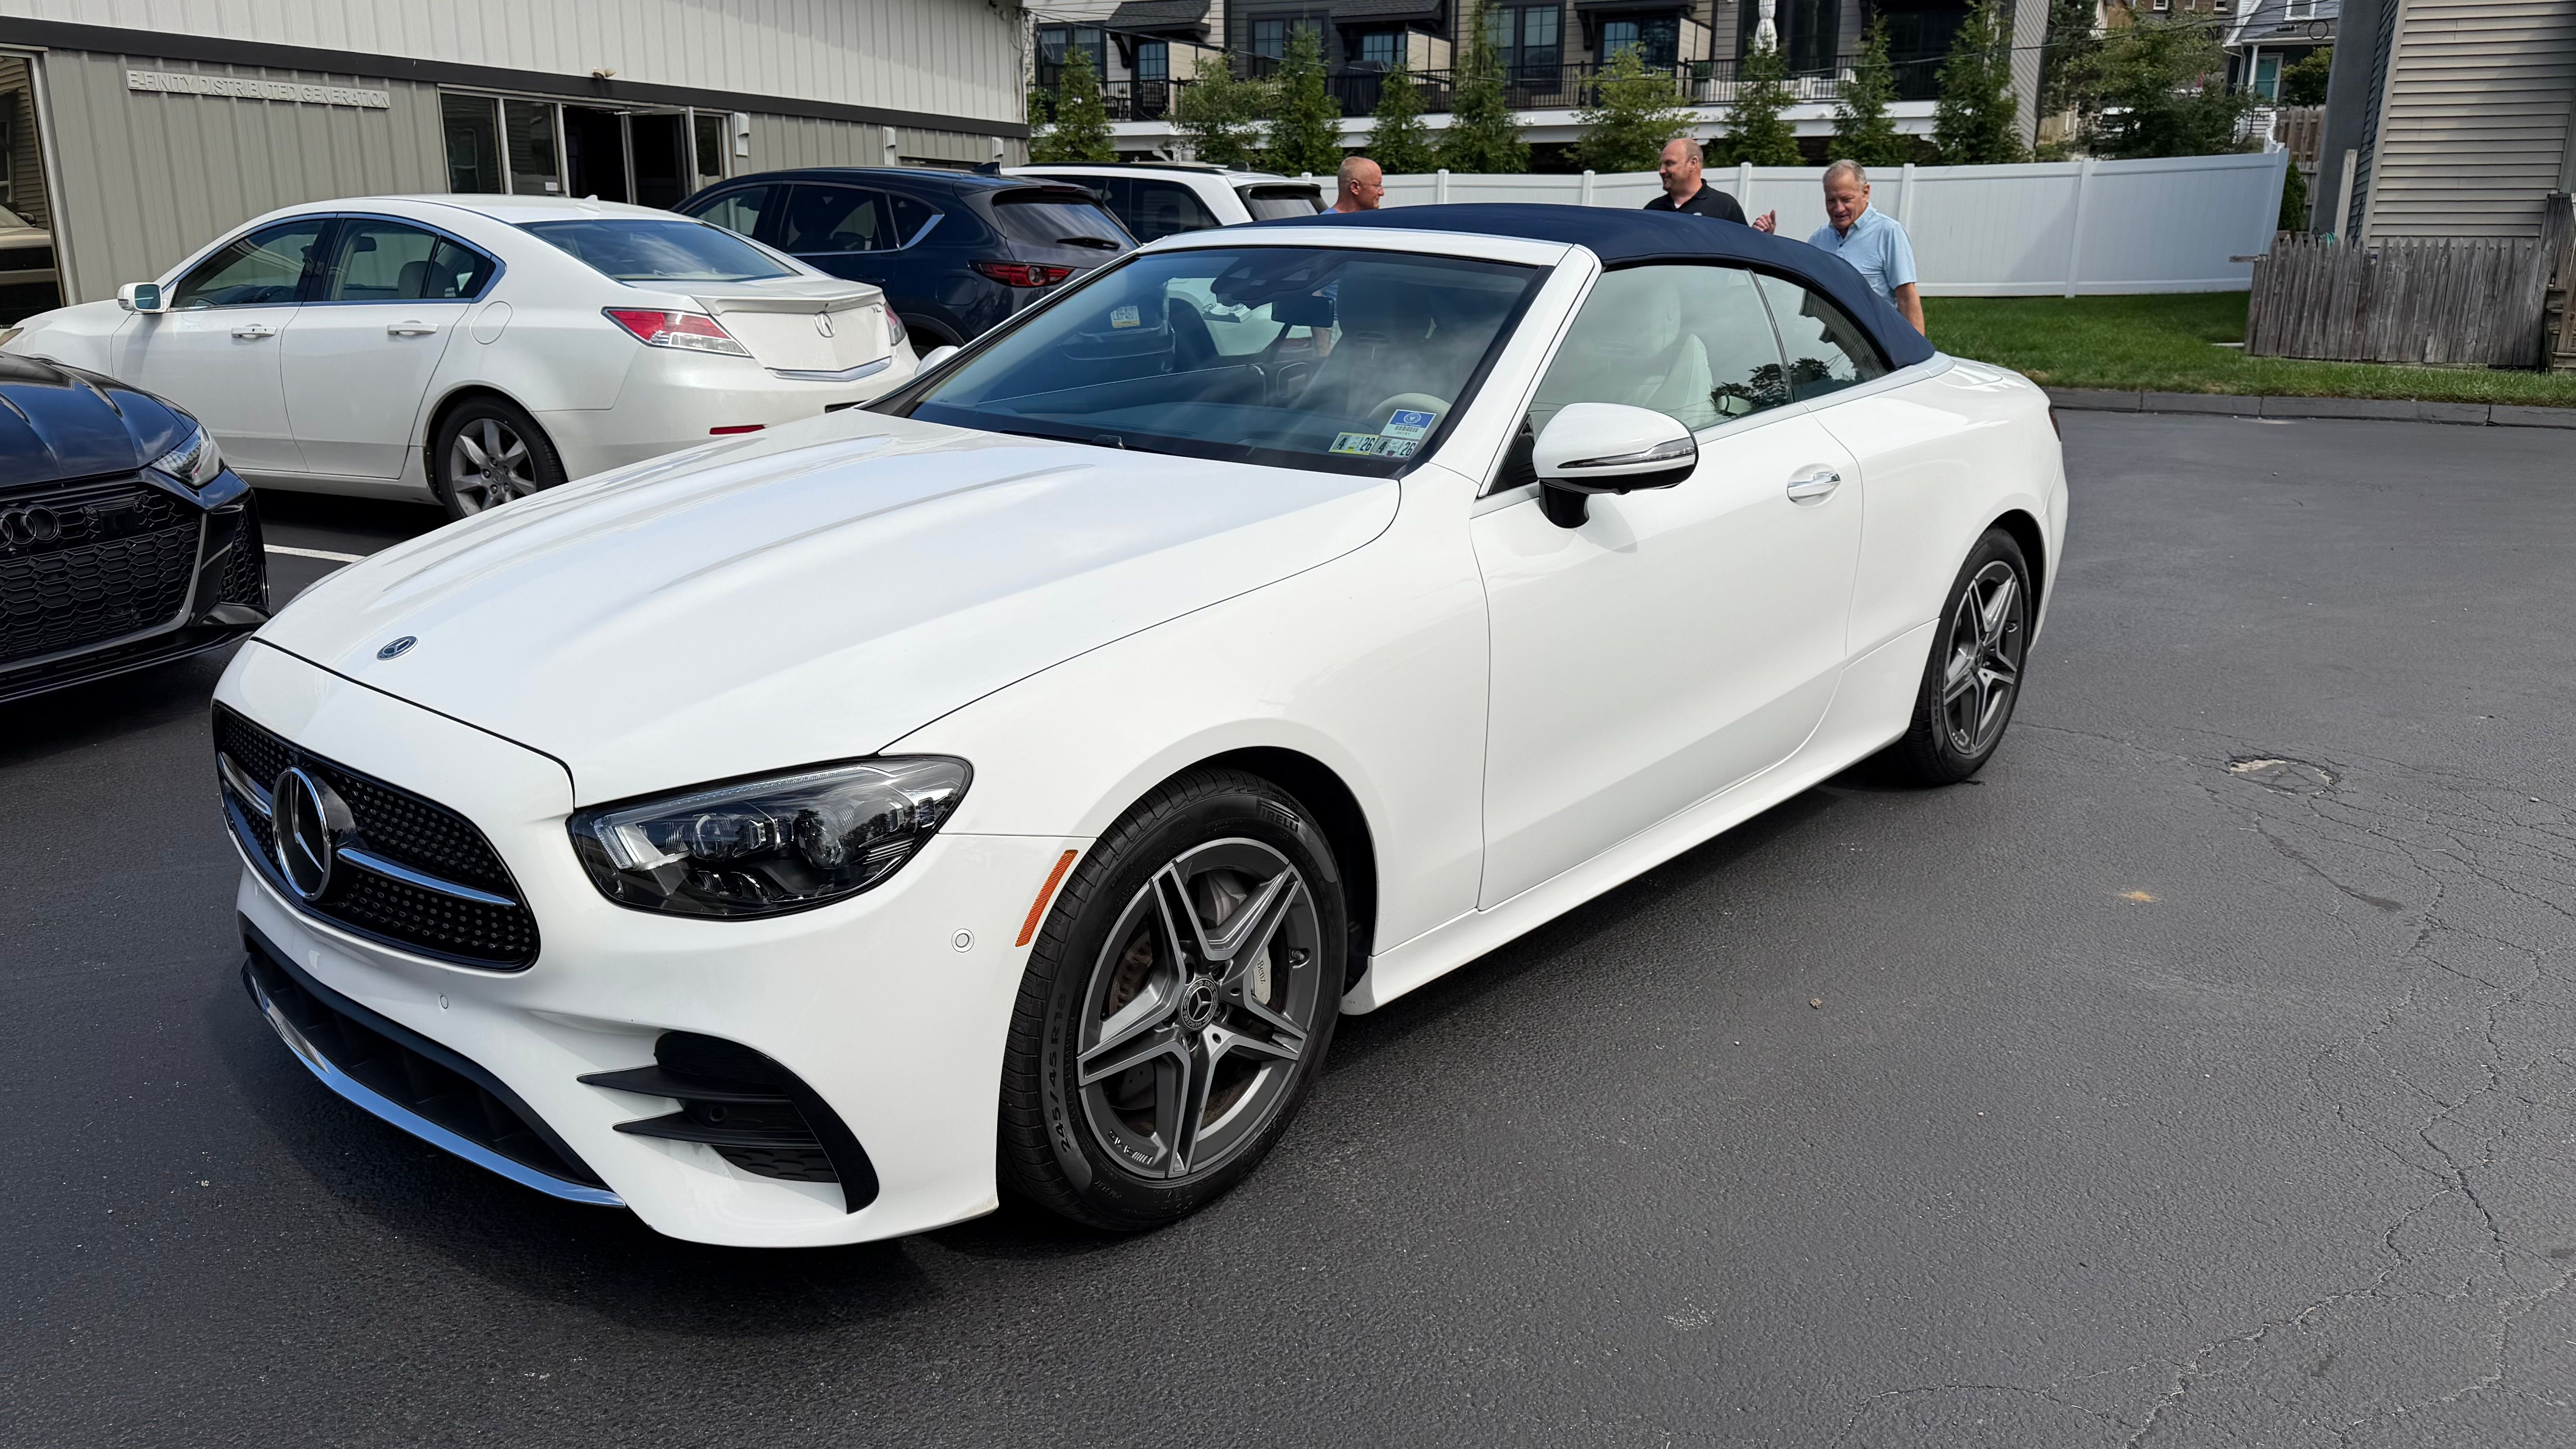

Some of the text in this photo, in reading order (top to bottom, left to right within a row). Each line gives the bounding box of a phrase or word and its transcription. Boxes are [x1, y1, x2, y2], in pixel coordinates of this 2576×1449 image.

[128, 71, 390, 107] E-FINITY DISTRIBUTED GENERATION
[1339, 437, 1348, 450] 4
[1360, 437, 1375, 451] 26
[1377, 441, 1388, 453] 4
[1400, 442, 1416, 456] 26
[1256, 797, 1300, 833] PIRELLI
